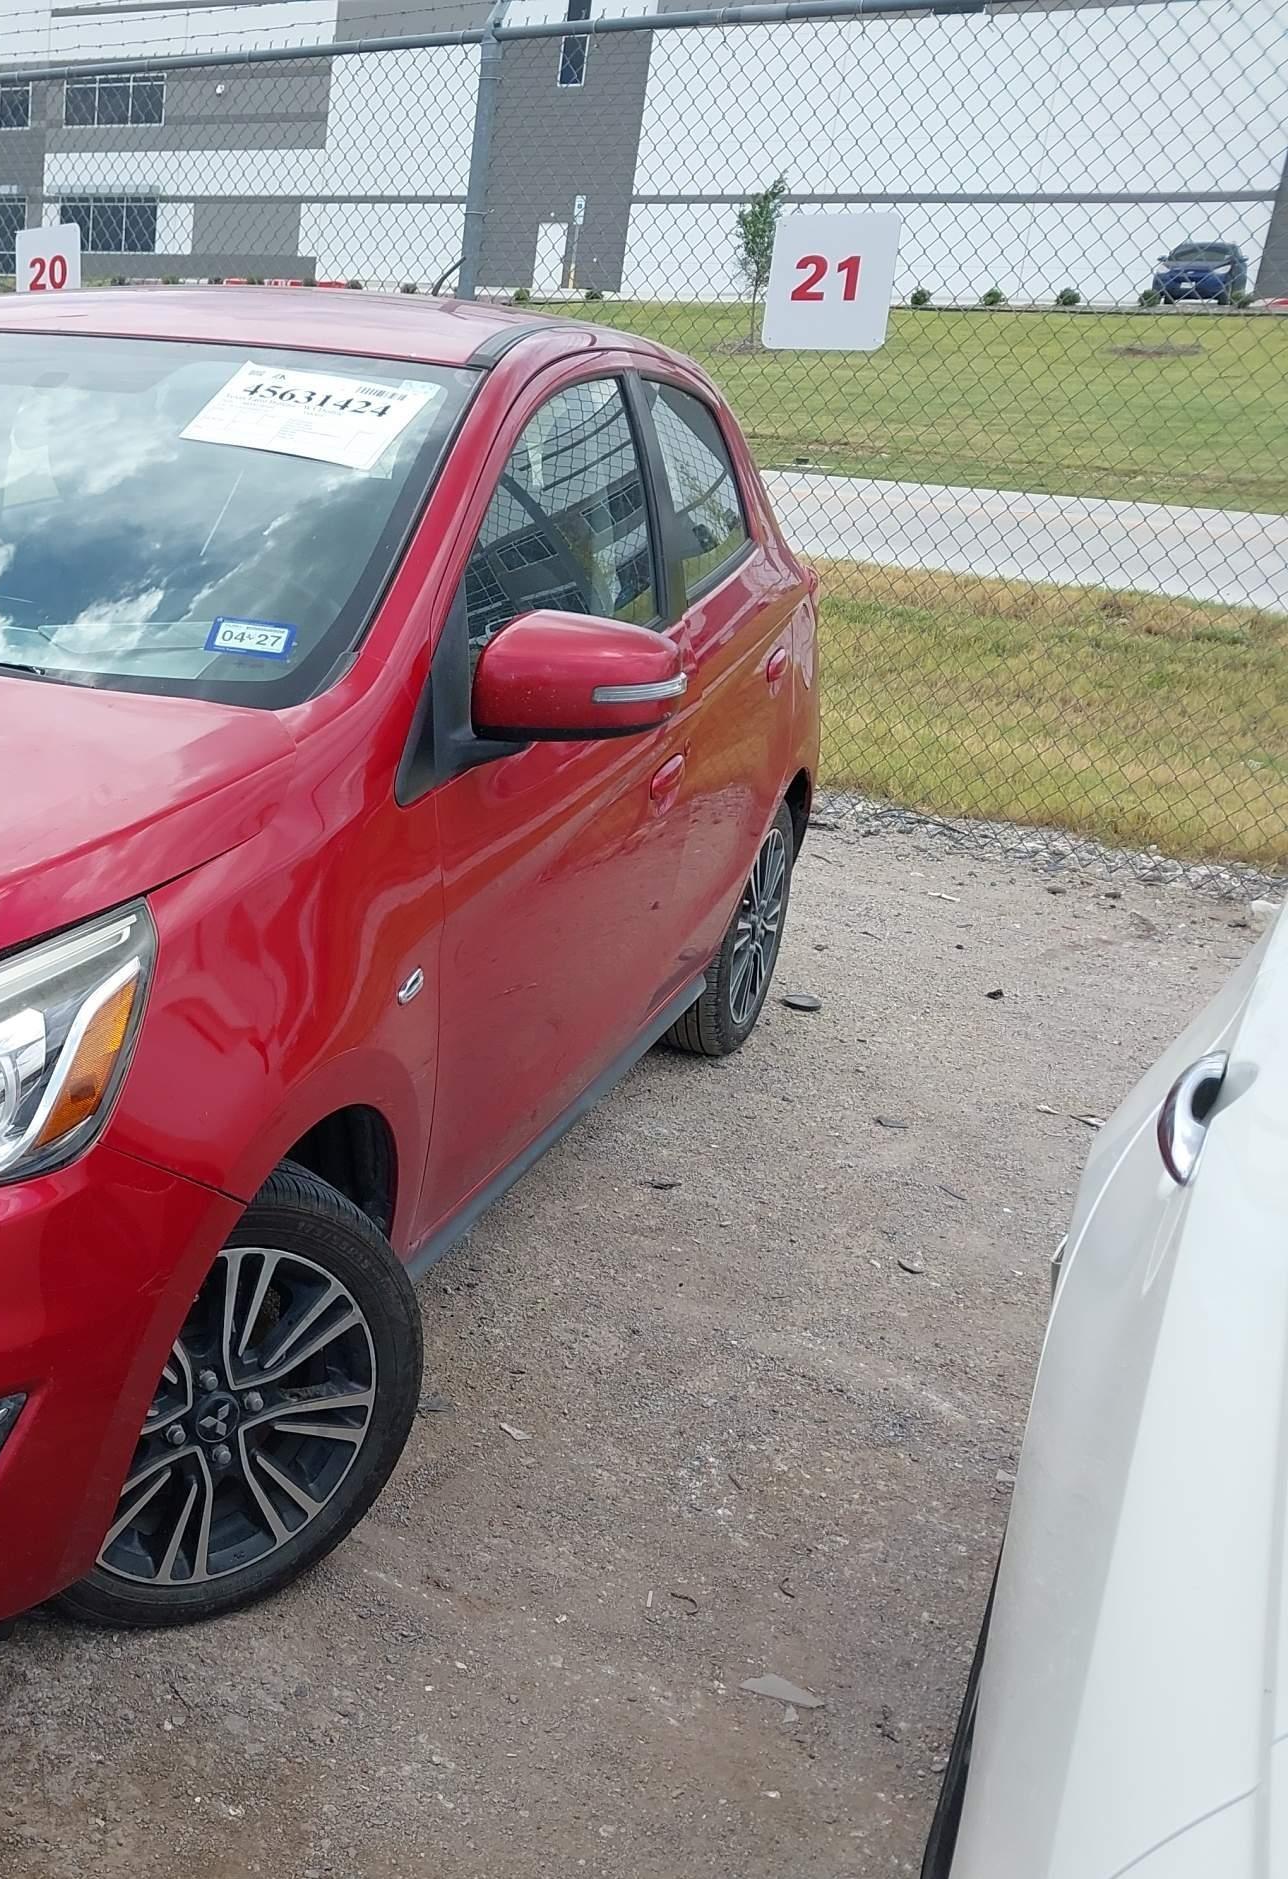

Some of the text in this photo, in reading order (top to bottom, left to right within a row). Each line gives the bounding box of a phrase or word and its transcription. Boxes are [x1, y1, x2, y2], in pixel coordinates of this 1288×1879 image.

[29, 254, 68, 292] 20
[790, 254, 862, 302] 21
[243, 383, 391, 418] 45631424
